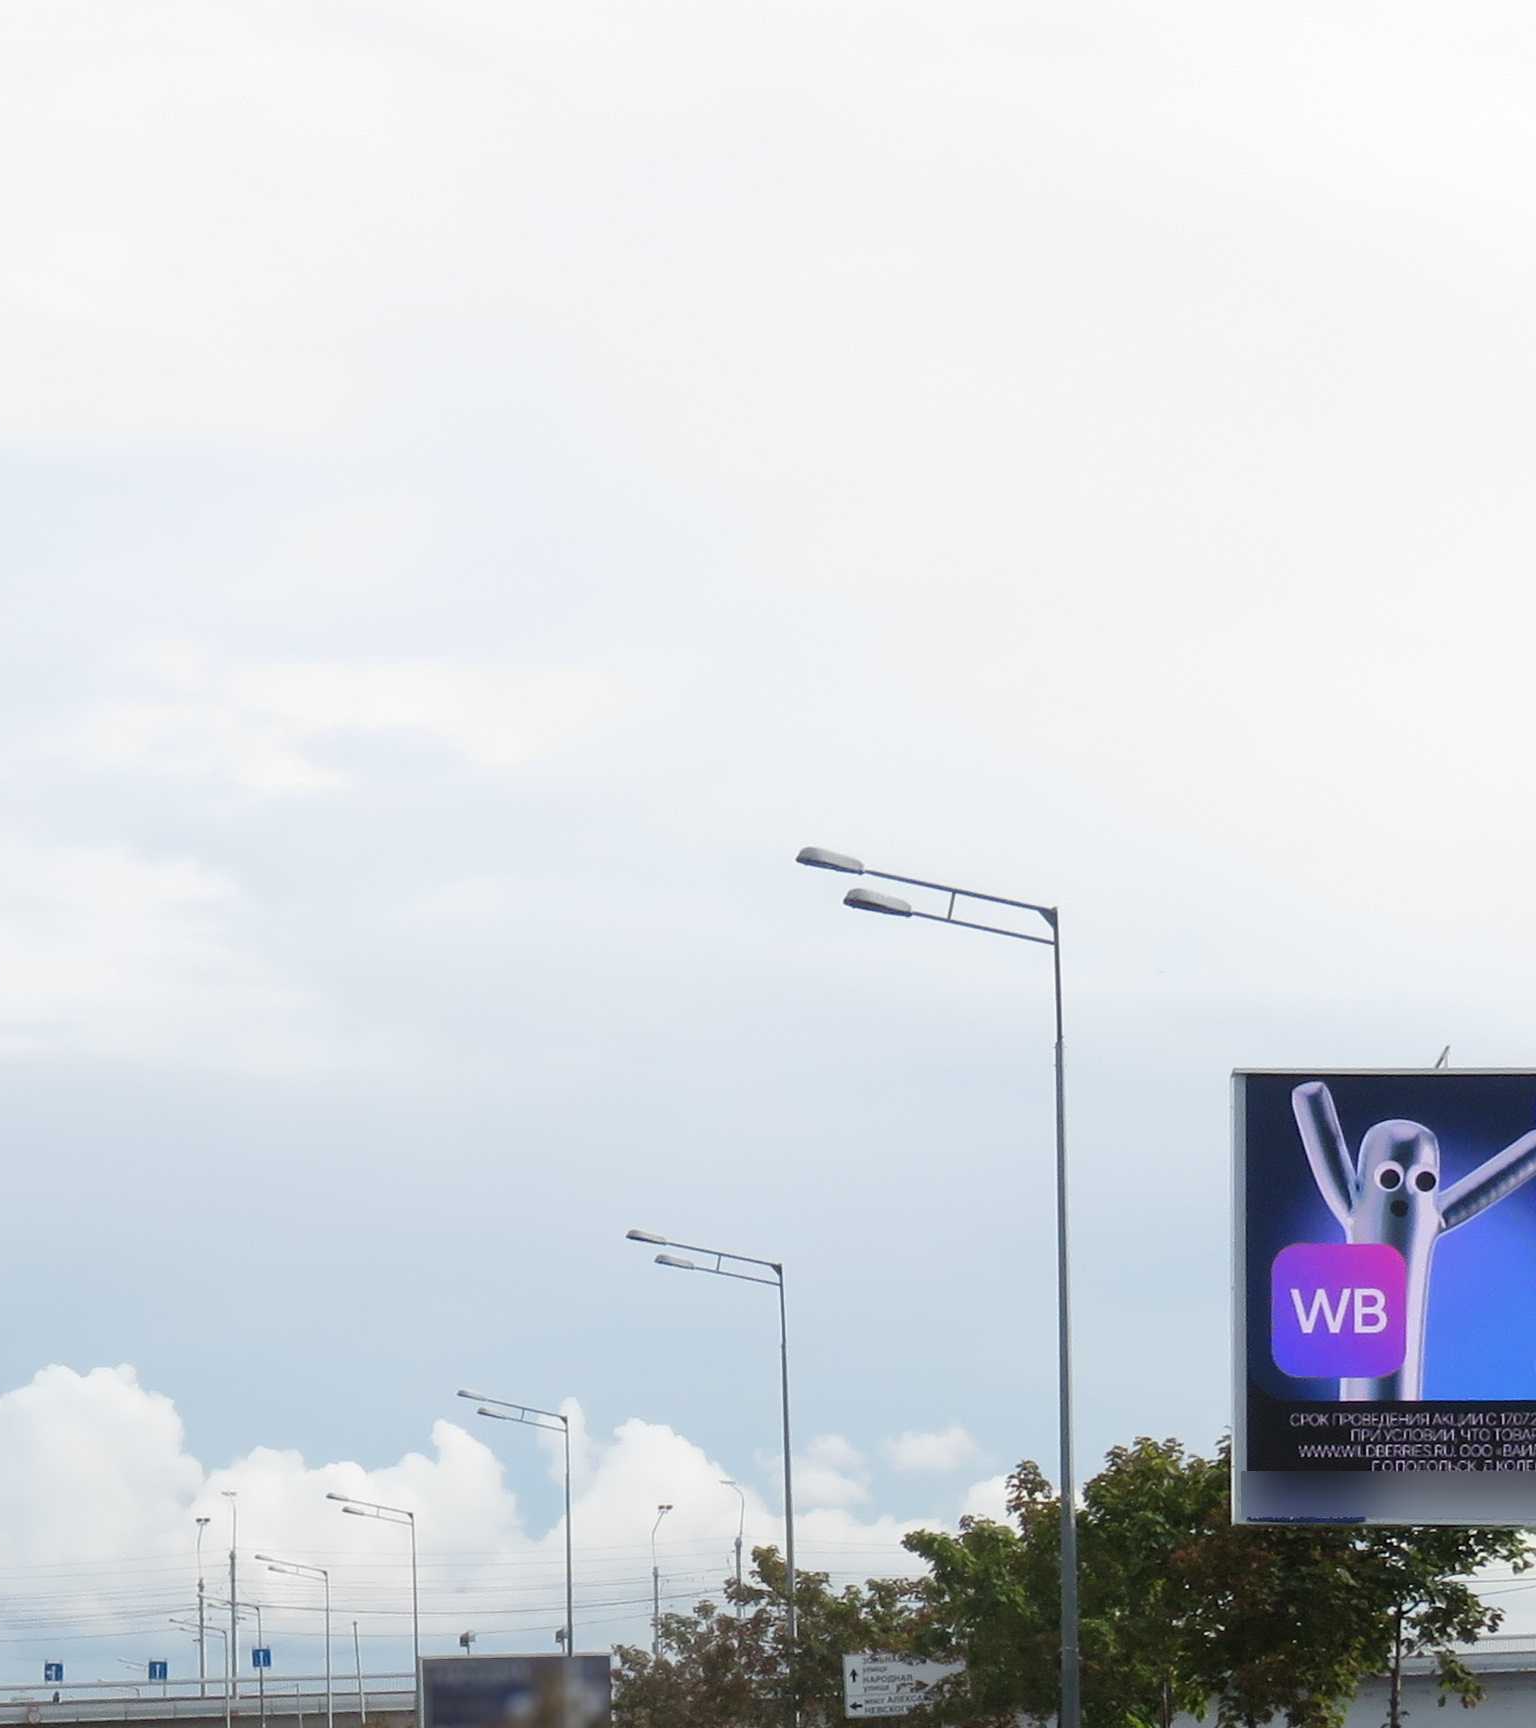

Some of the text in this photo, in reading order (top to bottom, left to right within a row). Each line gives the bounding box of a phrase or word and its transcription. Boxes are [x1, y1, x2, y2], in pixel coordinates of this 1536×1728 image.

[1290, 1288, 1387, 1333] WB
[1290, 1412, 1329, 1425] СРОК
[1332, 1412, 1429, 1427] ПРОВЕДЕНИЯ
[1432, 1412, 1483, 1427] АКЦИИ
[1486, 1412, 1497, 1425] С
[1350, 1428, 1380, 1441] ПРИ
[1460, 1428, 1490, 1441] ЧТО
[1459, 1444, 1493, 1457] ООО
